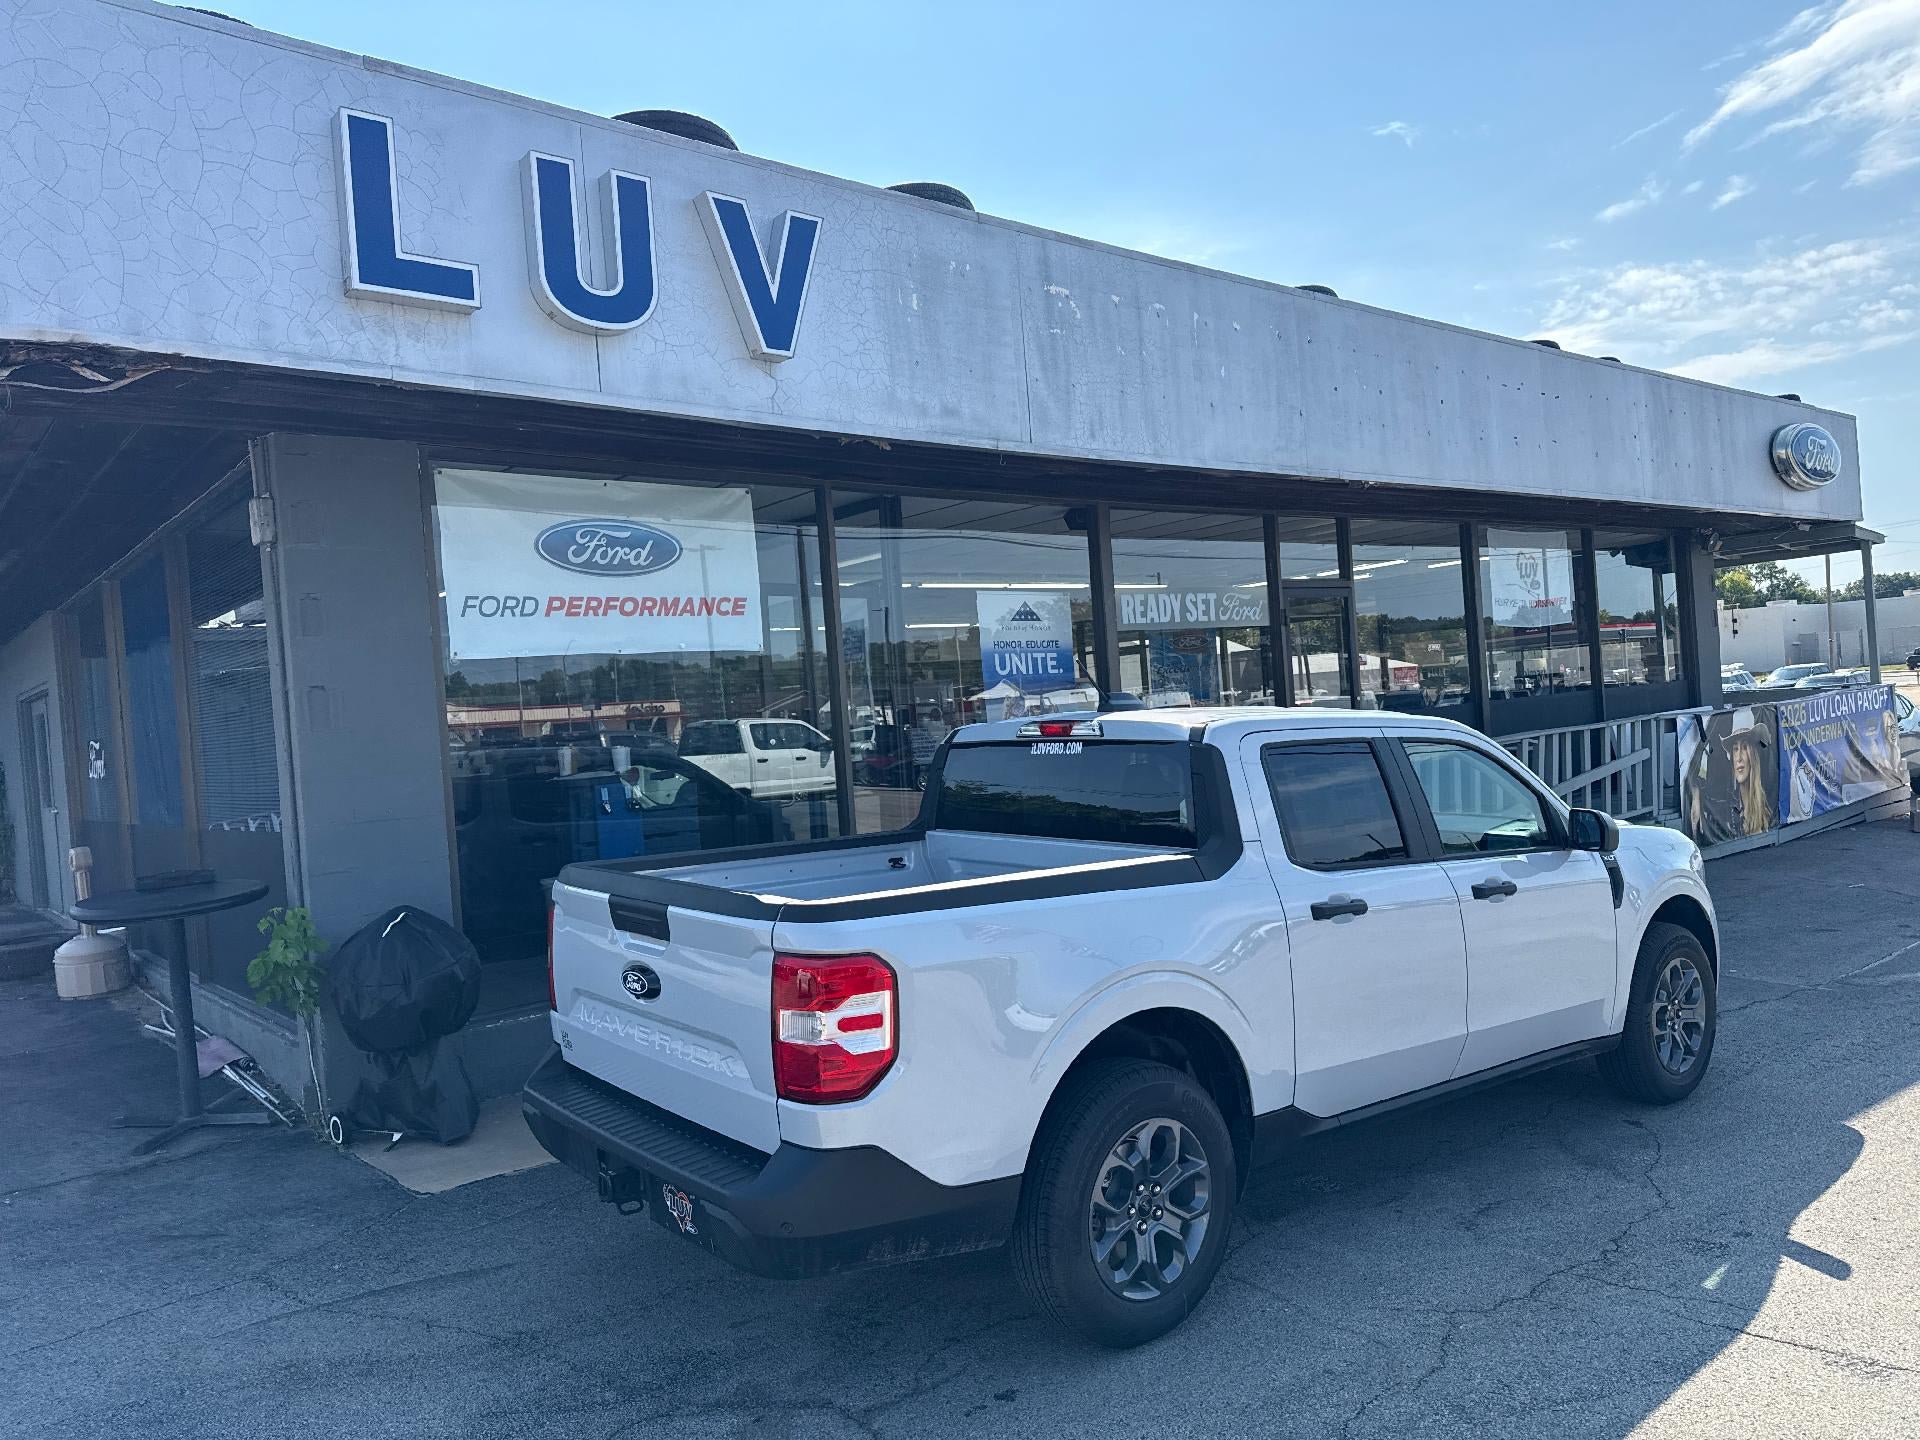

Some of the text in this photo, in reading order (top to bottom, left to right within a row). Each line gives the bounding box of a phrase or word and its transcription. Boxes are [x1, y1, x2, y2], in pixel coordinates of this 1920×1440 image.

[332, 107, 824, 362] LUV
[1805, 435, 1836, 474] Ford
[568, 527, 654, 566] Ford
[460, 595, 747, 618] FORD PERFORMANCE
[1120, 592, 1263, 625] READY SET Ford
[994, 652, 1064, 675] UNITE.
[1808, 698, 1829, 723] LUV
[1829, 692, 1856, 718] LOAN
[1857, 686, 1888, 713] PAYOFF
[88, 740, 105, 780] Ford
[577, 1003, 737, 1078] MAVERICK
[669, 1193, 692, 1221] LUV
